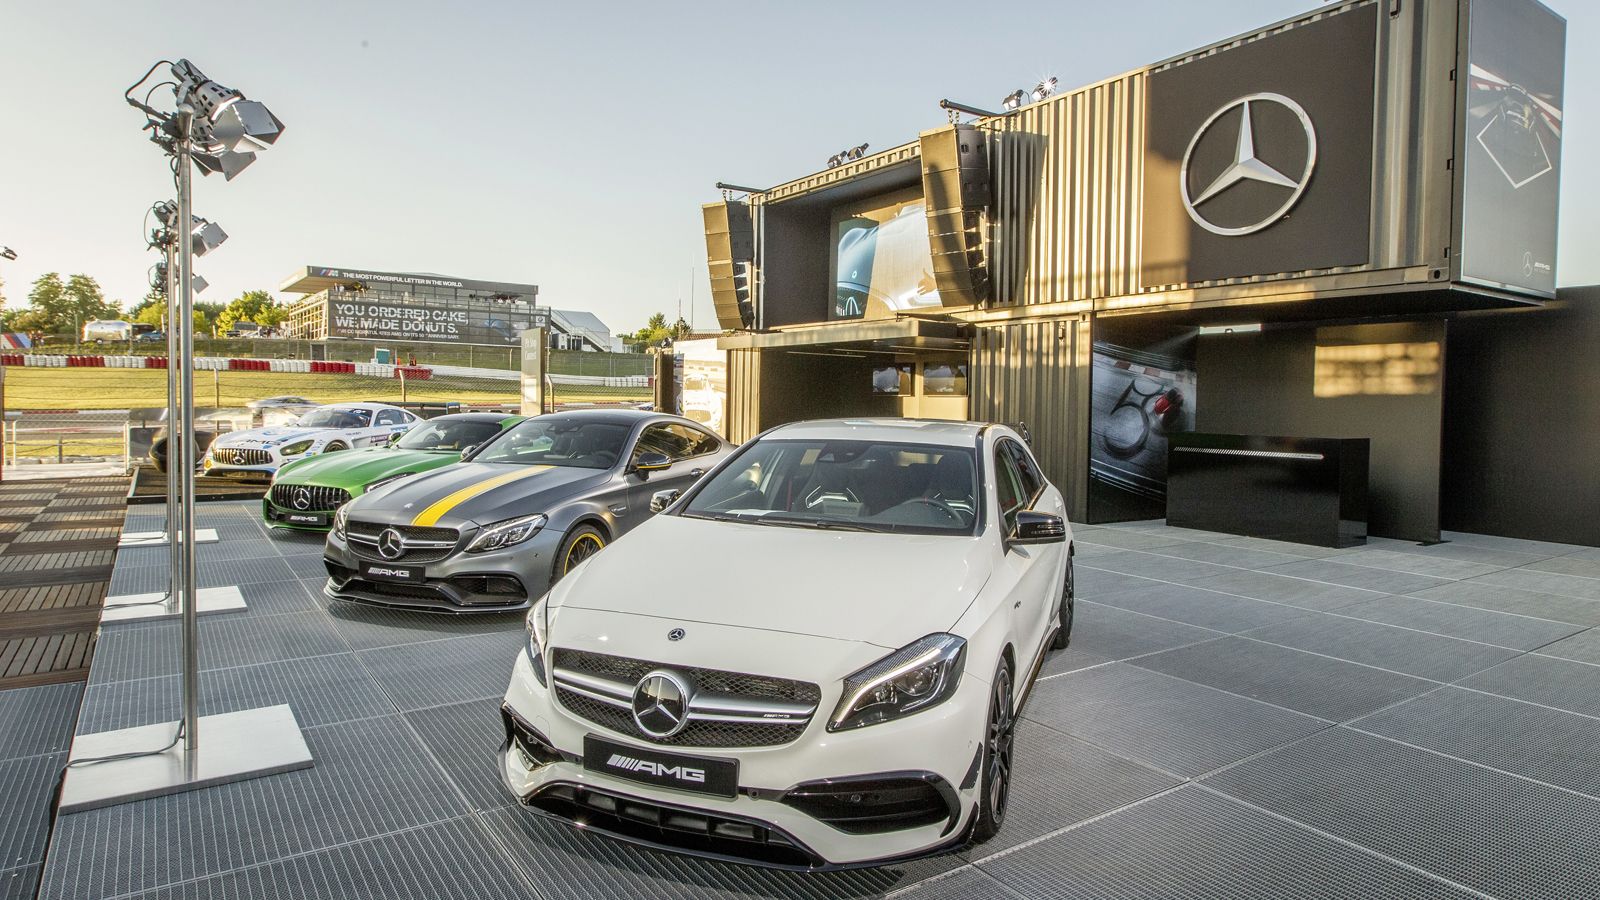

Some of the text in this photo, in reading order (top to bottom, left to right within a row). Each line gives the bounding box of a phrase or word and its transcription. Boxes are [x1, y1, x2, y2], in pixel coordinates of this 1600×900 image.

[335, 303, 469, 325] YOU ORDERED CAKE,
[360, 317, 399, 330] MADE
[402, 320, 459, 334] DONUTS.
